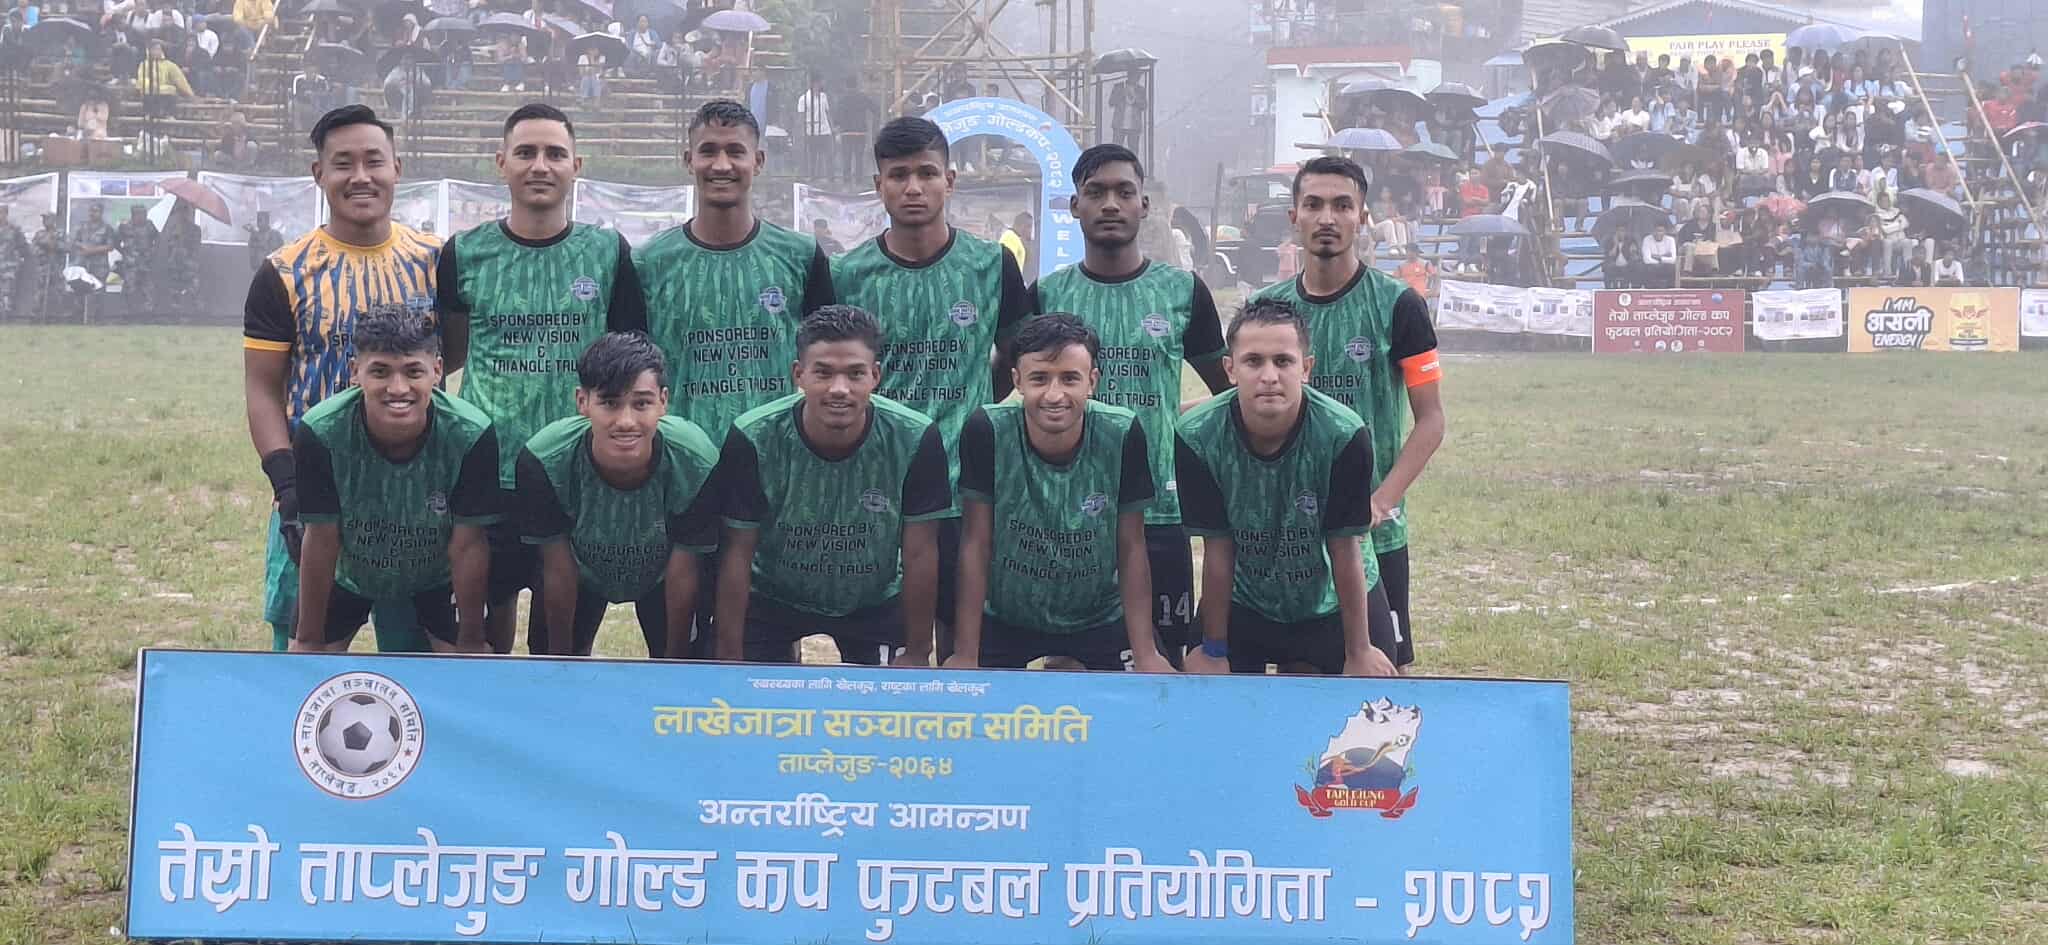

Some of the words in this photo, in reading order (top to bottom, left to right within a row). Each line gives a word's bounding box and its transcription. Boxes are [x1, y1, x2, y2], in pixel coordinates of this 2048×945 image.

[1669, 40, 1694, 50] FAIR
[1698, 40, 1725, 49] PLAY
[1729, 39, 1771, 48] PLEASE
[490, 314, 570, 327] SPONSORED
[572, 313, 590, 326] BY
[503, 331, 533, 344] NEW
[537, 330, 580, 344] VISION
[760, 327, 778, 341] BY
[949, 339, 968, 353] BY
[694, 348, 722, 362] NEW
[726, 346, 769, 360] VISION
[1142, 348, 1160, 360] BY
[492, 360, 551, 373] TRIANGLE
[555, 359, 577, 372] TRU
[887, 360, 914, 372] NEW
[1108, 365, 1149, 377] VISION
[683, 379, 745, 395] TRIANGLE
[1345, 374, 1362, 388] BY
[932, 386, 968, 400] TRUST
[1126, 393, 1162, 407] TRUST
[356, 532, 387, 546] NEW
[821, 539, 867, 551] VISION
[1158, 591, 1191, 625] 14
[652, 697, 816, 738] लाखेजात्रा
[822, 709, 977, 742] सञ्चालन
[981, 704, 1093, 743] समिति
[1325, 788, 1386, 800] TAPLEJUNG
[888, 802, 1031, 832] आमन्त्रण
[157, 822, 281, 913] तेस्रो
[298, 826, 546, 936] ताप्लेजुङ
[563, 831, 719, 911] गोल्ड
[735, 850, 839, 914] कप
[856, 858, 1050, 942] फुटबल
[1063, 847, 1333, 929] प्रतियोगिता
